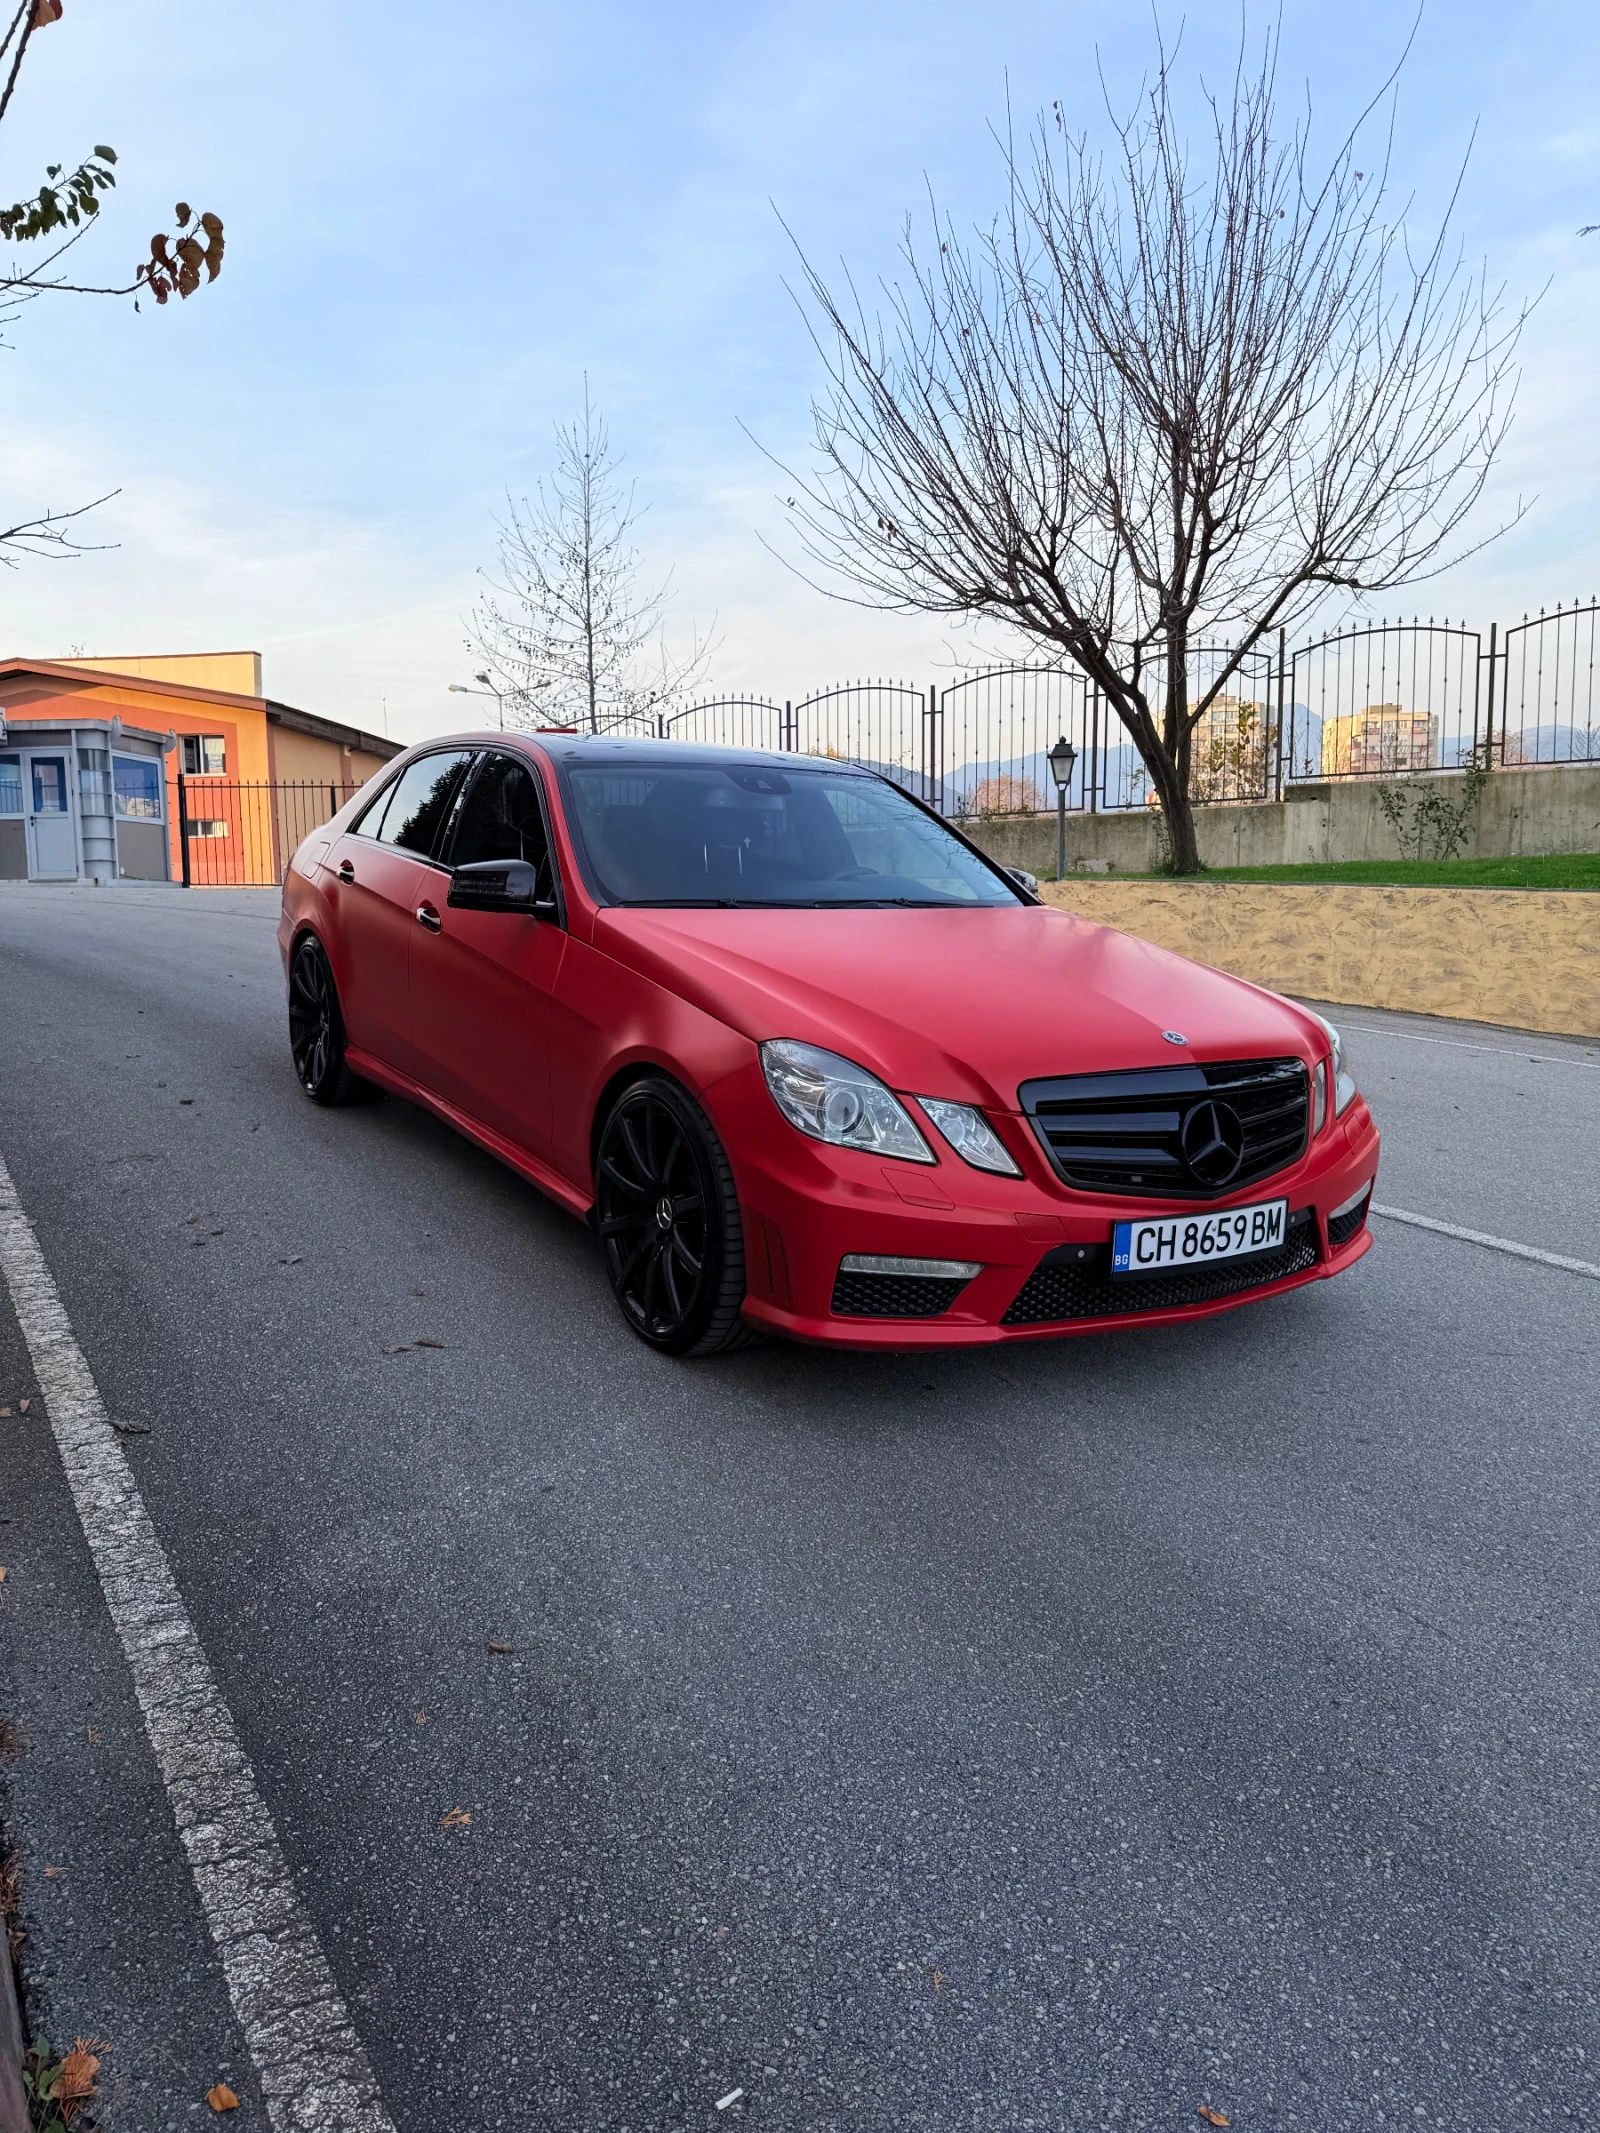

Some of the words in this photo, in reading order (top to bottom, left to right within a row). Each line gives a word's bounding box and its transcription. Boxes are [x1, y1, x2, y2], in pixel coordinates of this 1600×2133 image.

[1136, 1225, 1177, 1263] CH
[1182, 1215, 1247, 1257] 8659
[1251, 1207, 1282, 1246] BM
[1115, 1254, 1129, 1266] BG
